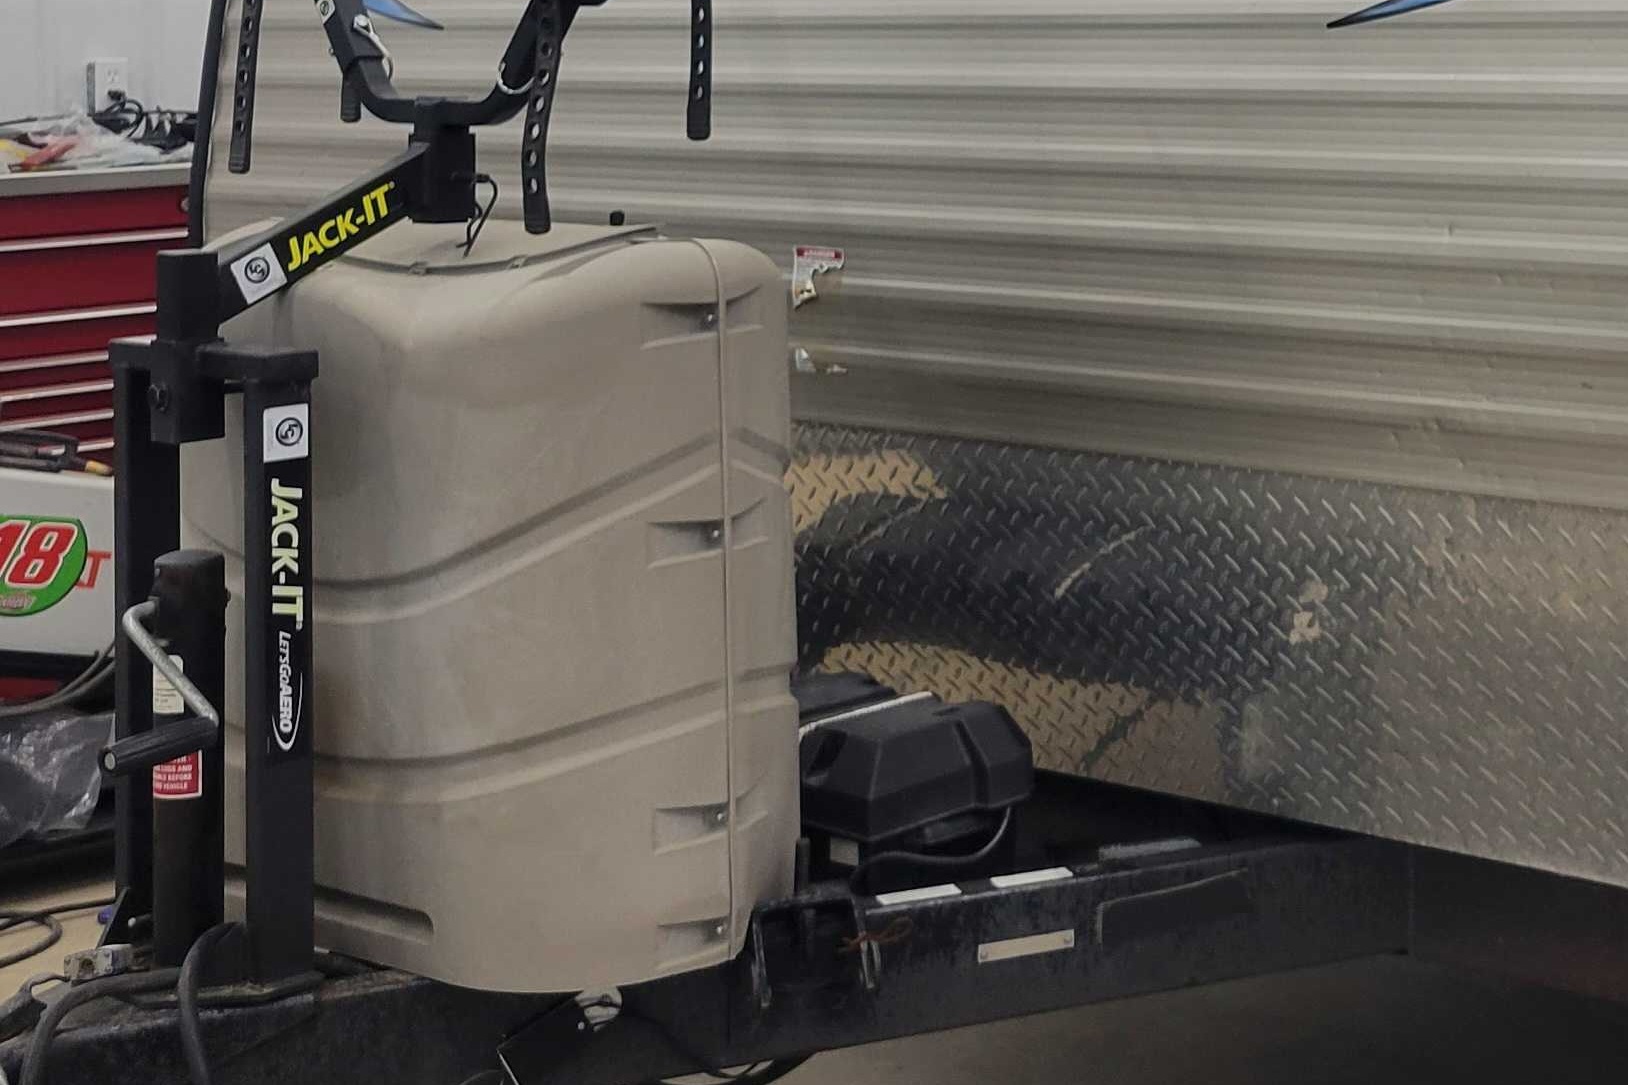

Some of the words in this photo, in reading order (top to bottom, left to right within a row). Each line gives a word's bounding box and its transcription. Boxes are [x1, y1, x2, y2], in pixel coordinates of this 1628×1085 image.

[288, 183, 390, 272] JACK-IT
[0, 519, 78, 588] 18
[271, 478, 303, 615] JACK-IT
